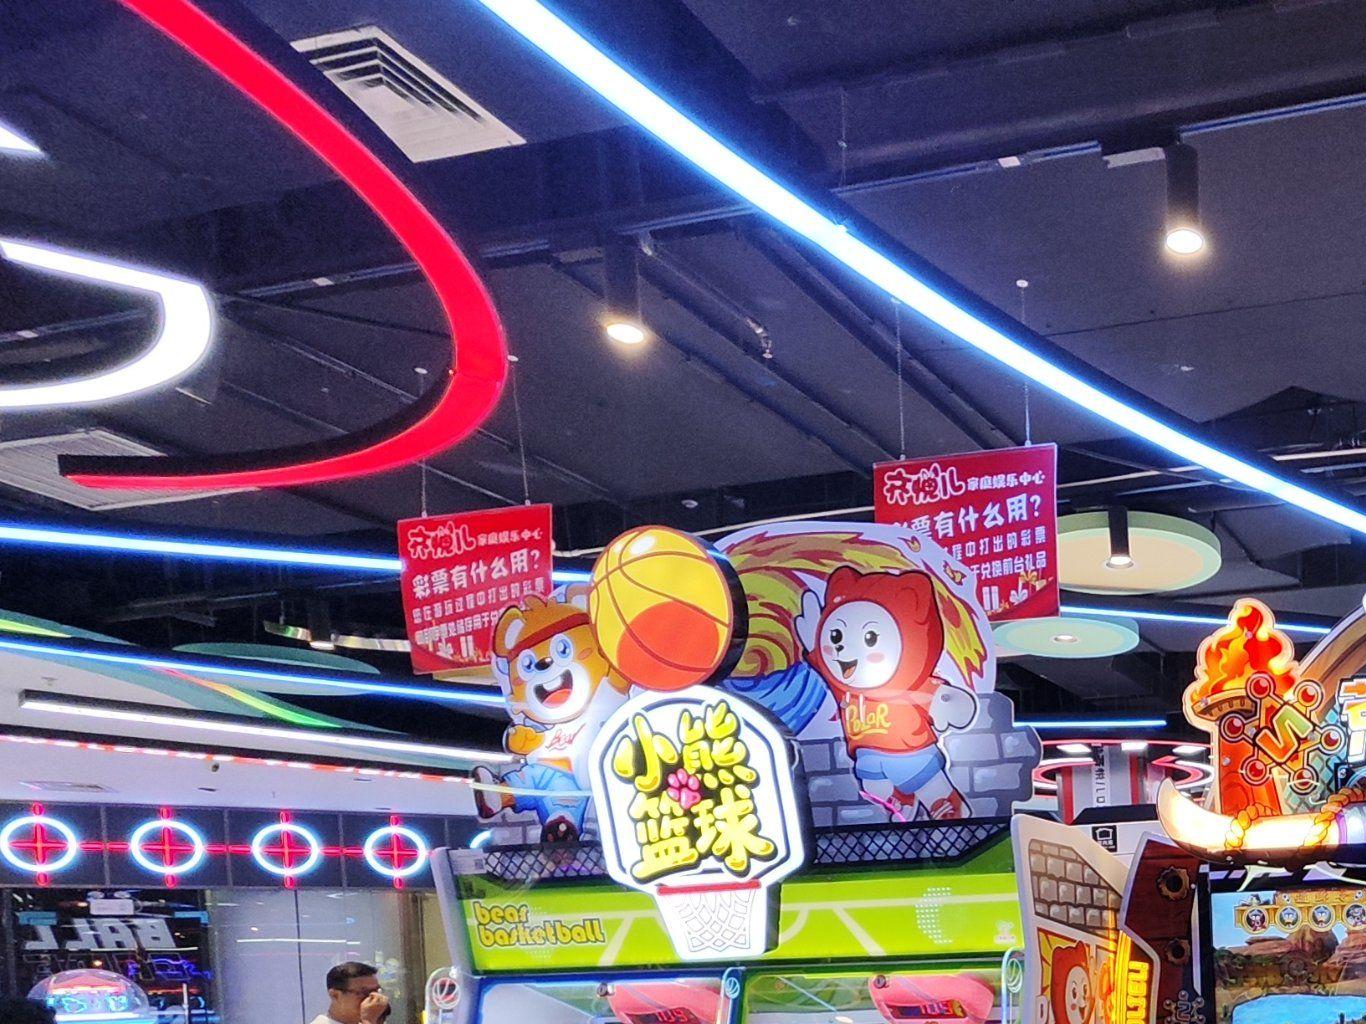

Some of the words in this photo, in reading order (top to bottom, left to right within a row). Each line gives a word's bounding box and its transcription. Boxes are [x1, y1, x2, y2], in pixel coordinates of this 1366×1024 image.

[611, 699, 760, 795] 小熊
[473, 901, 528, 925] bear
[478, 919, 606, 947] basketball
